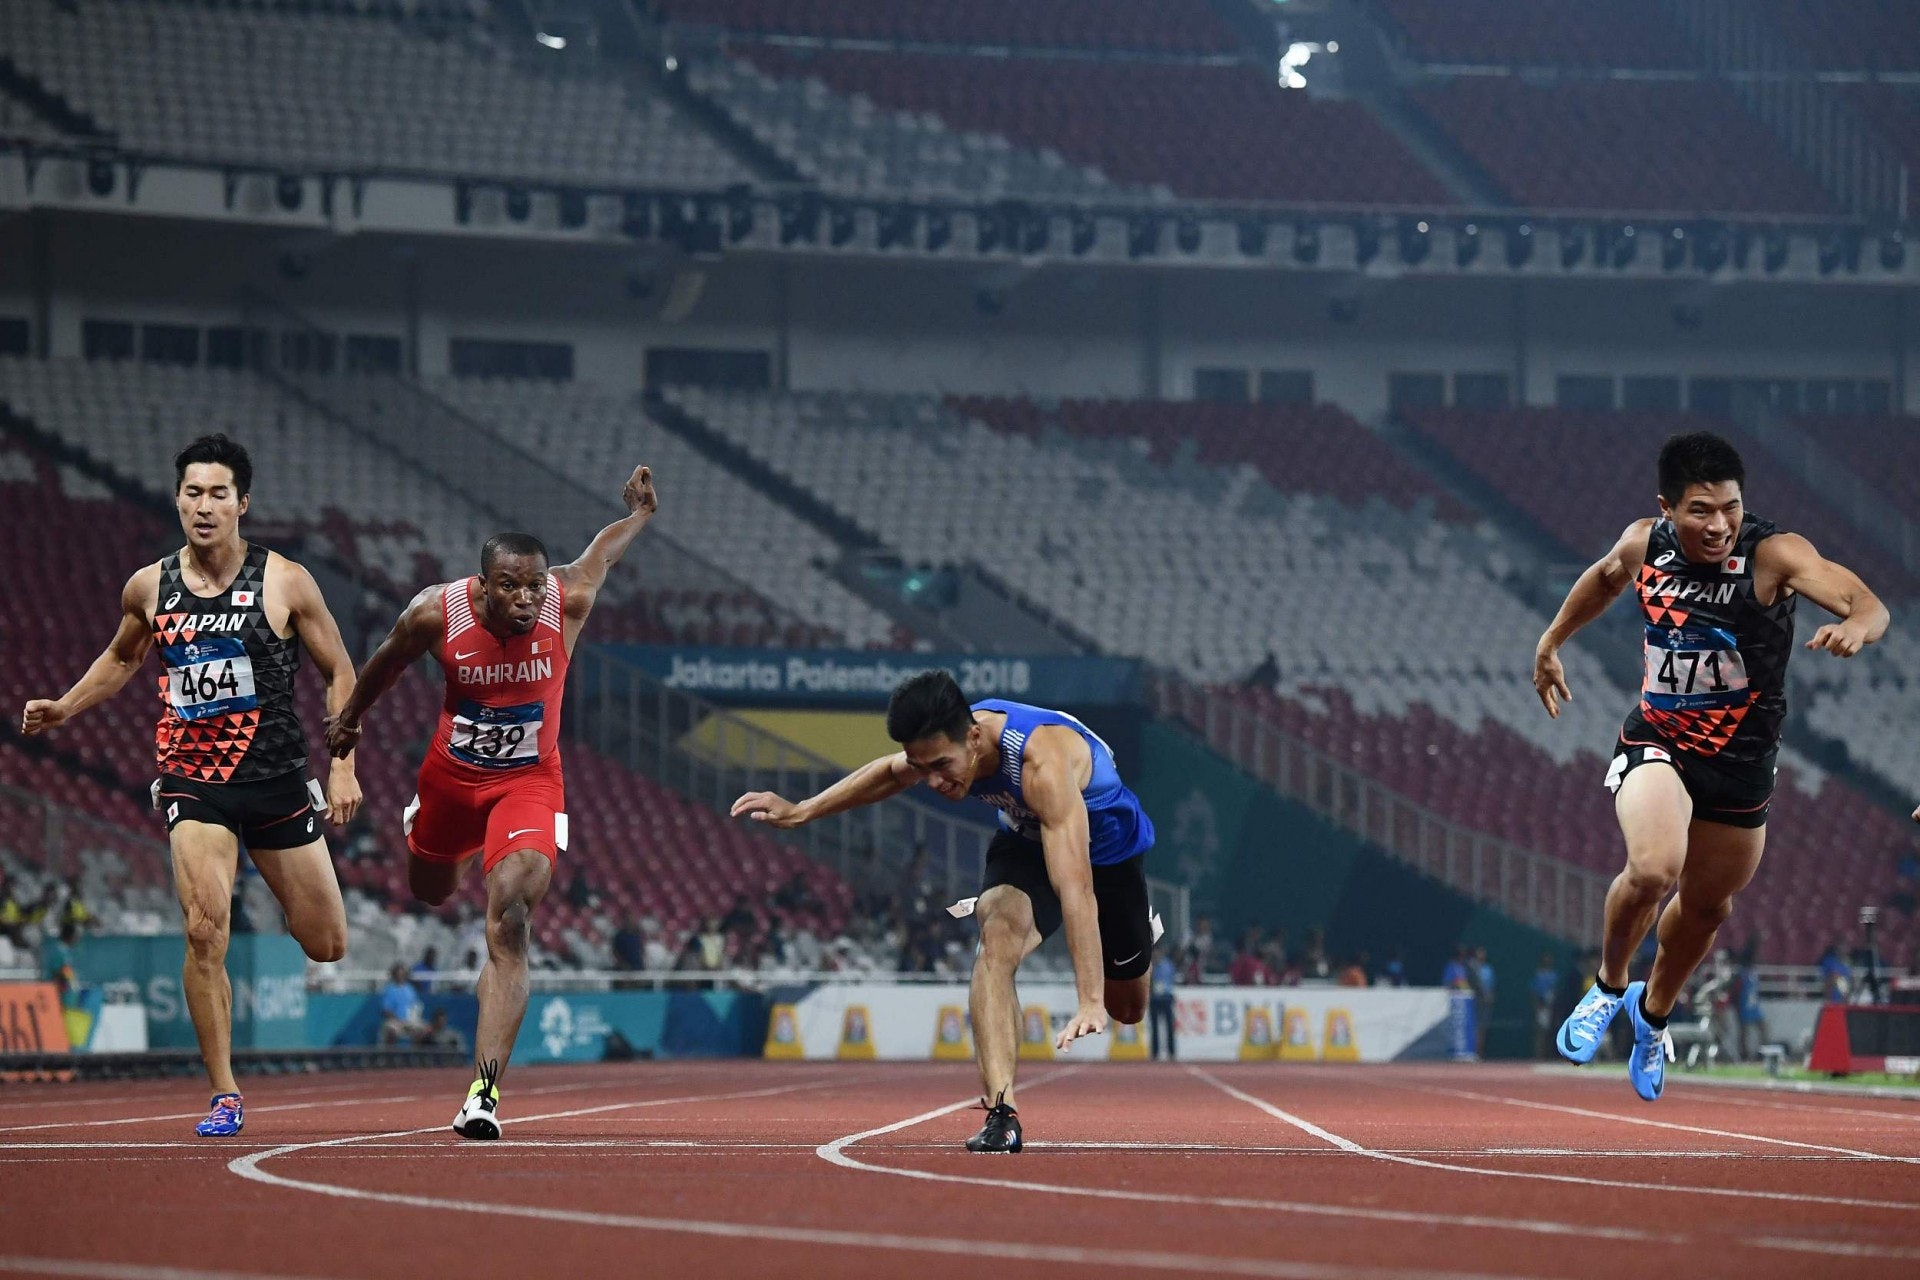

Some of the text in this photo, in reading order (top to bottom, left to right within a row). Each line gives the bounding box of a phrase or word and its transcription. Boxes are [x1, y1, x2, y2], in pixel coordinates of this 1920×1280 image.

[1646, 577, 1736, 605] JAPAN
[168, 613, 247, 633] JAPAN
[181, 660, 239, 703] 464
[457, 656, 553, 685] BAHRAIN
[664, 656, 781, 690] Jakarta
[960, 660, 1031, 694] 2018
[1657, 651, 1729, 693] 471
[463, 722, 526, 758] 139
